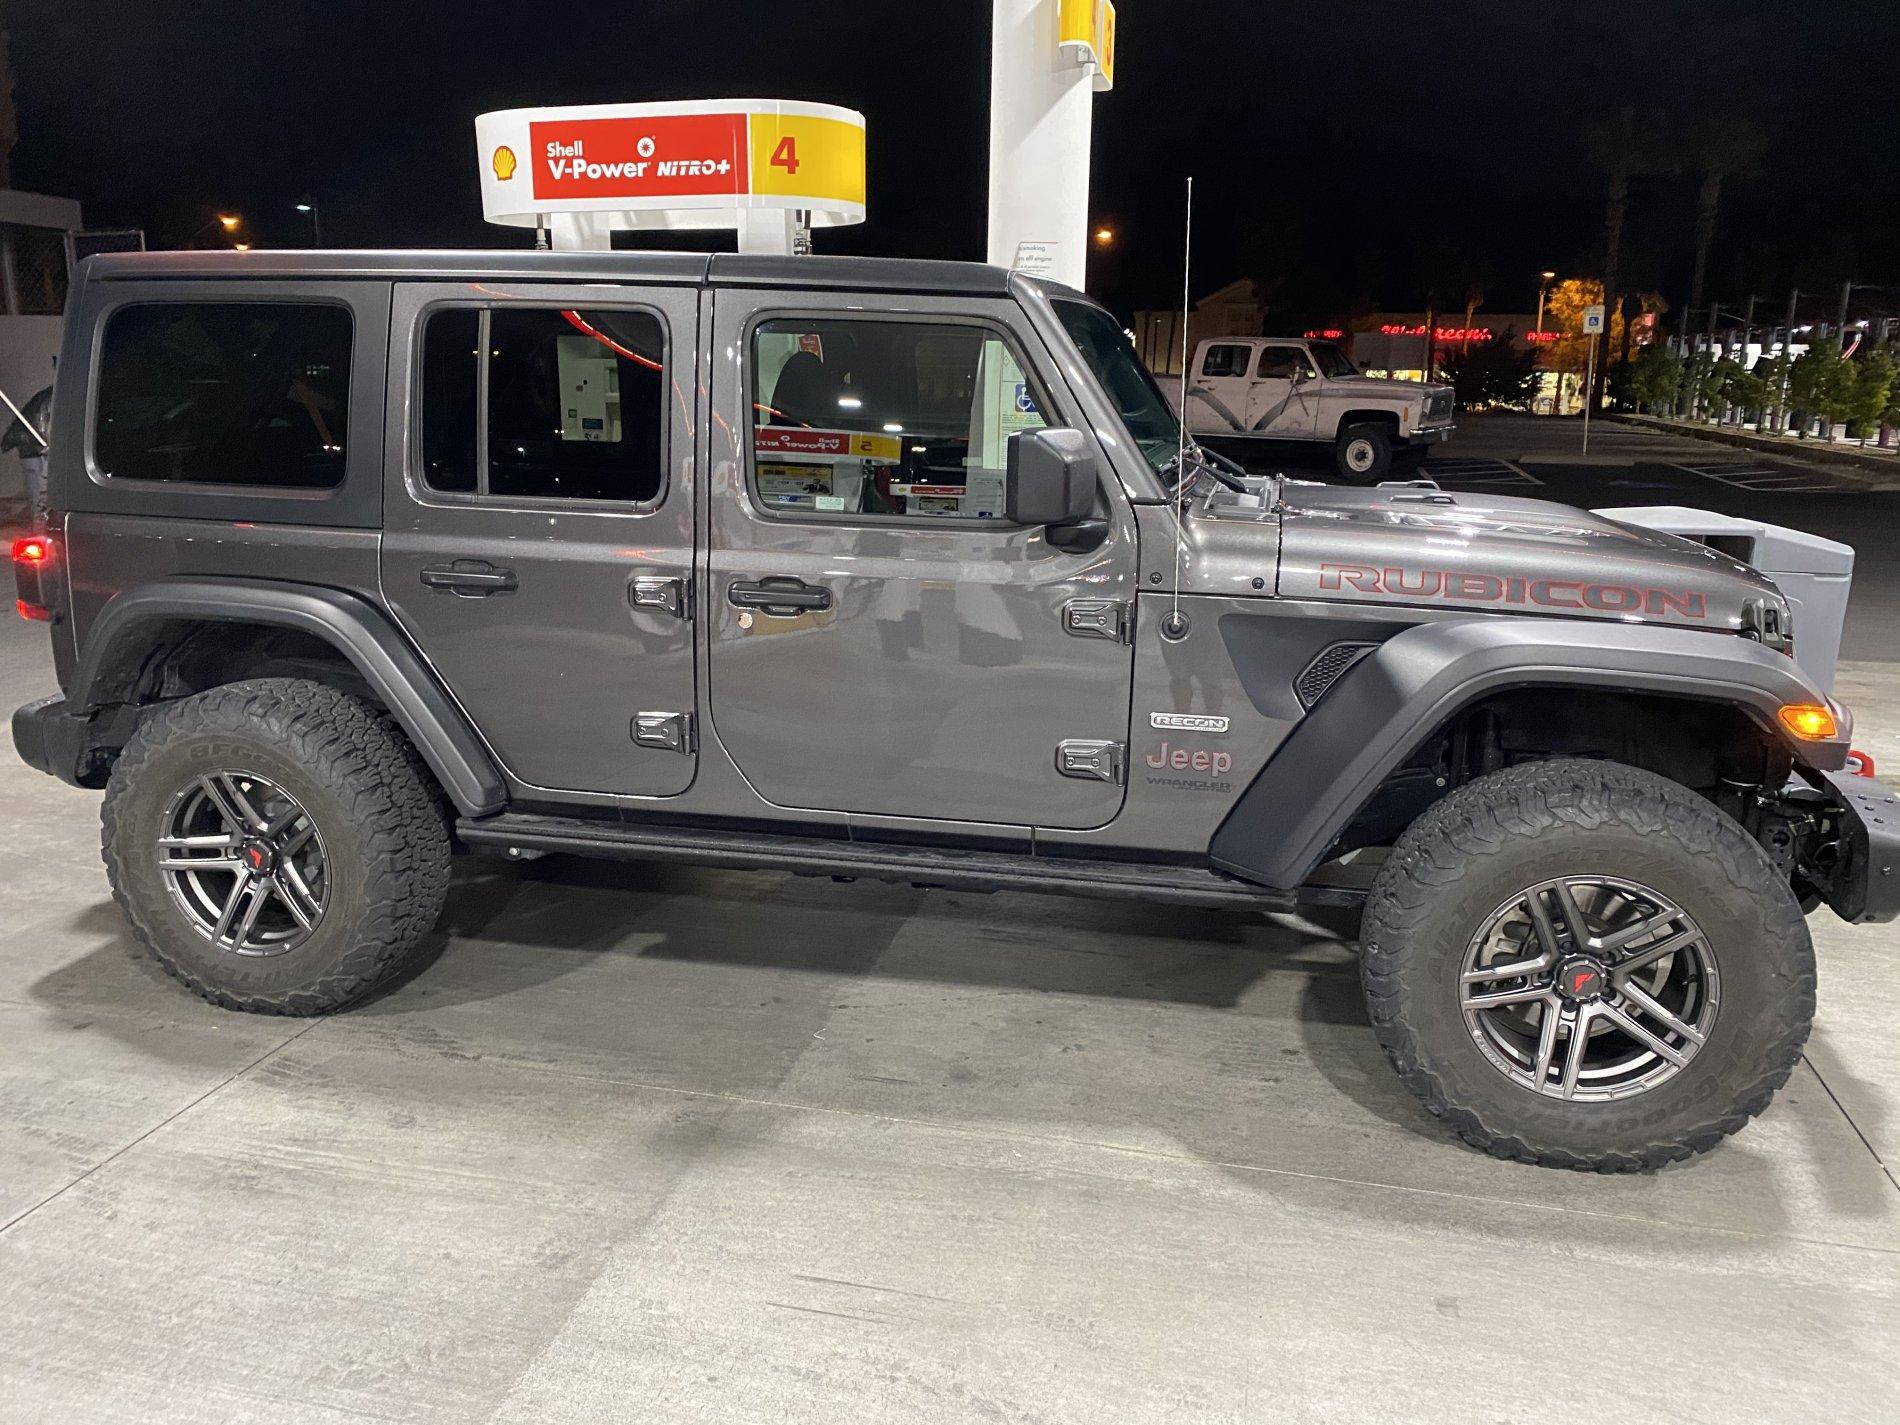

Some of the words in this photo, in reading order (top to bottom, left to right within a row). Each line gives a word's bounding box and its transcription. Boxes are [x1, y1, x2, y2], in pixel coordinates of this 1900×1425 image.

[547, 140, 583, 158] Shell
[771, 137, 800, 175] 4
[1320, 563, 1706, 618] RUBICON
[1156, 716, 1224, 728] RECON
[1146, 742, 1232, 777] Jeep
[1146, 777, 1231, 790] WRANGLER
